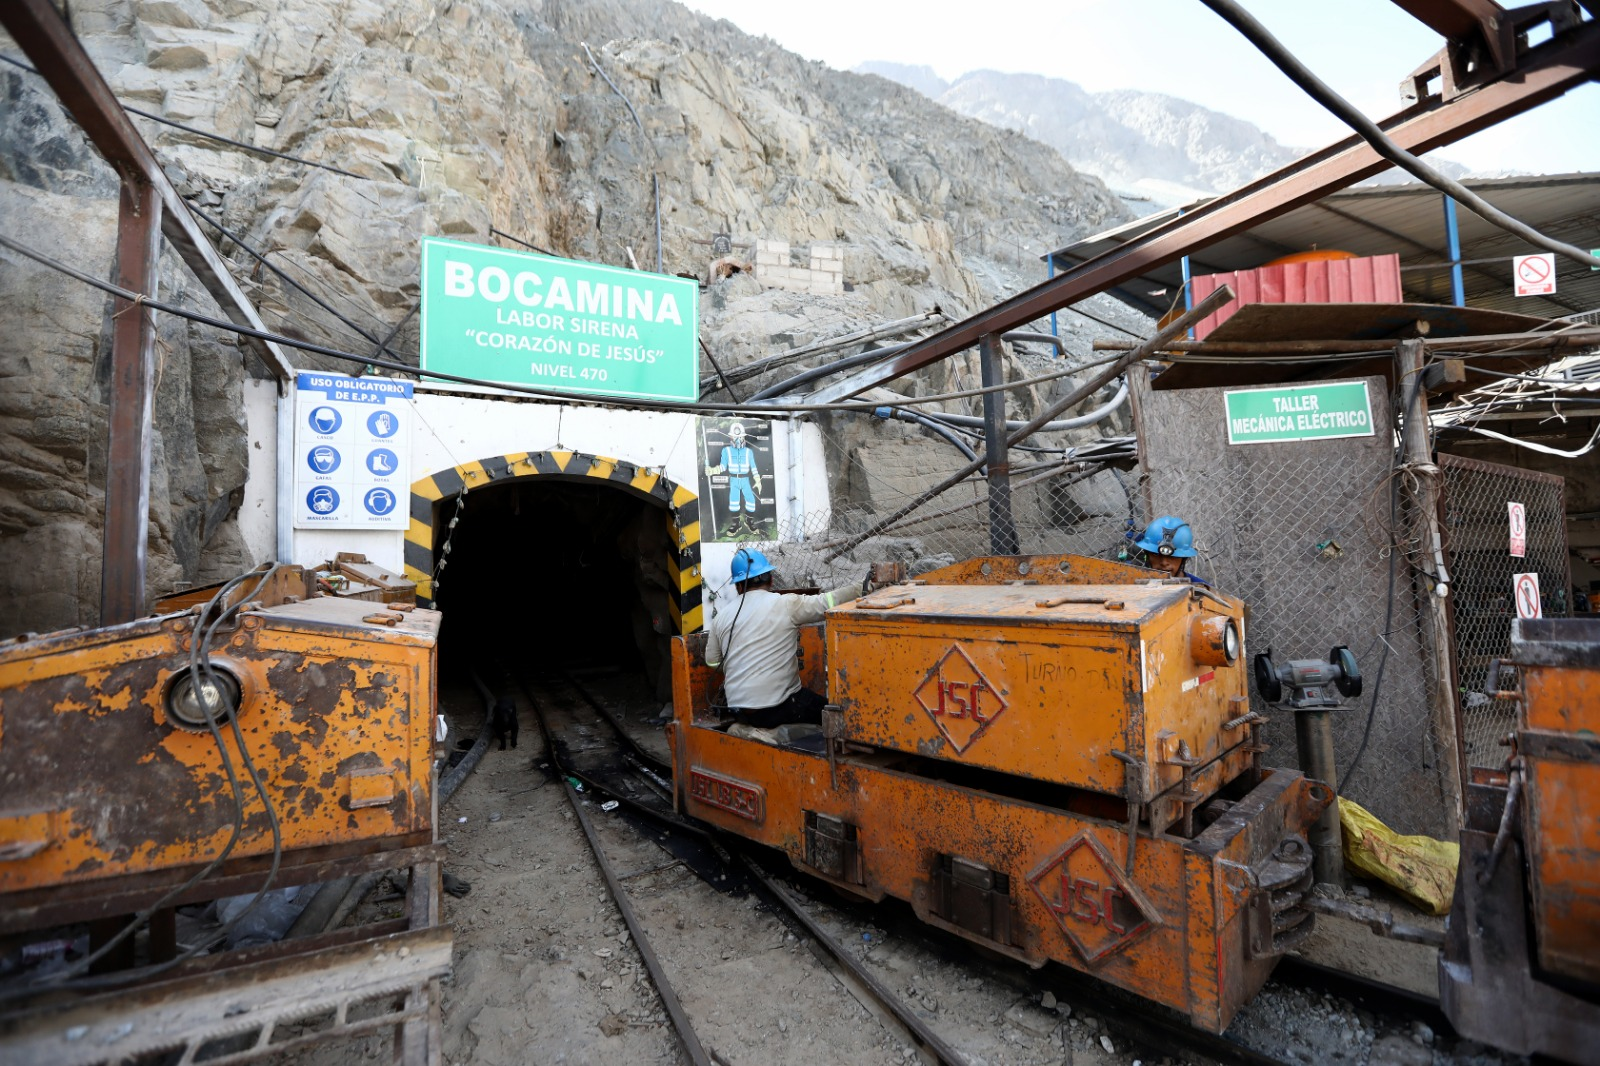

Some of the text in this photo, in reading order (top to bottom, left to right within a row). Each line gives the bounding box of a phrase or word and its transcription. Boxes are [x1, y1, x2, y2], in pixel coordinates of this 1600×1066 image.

[444, 260, 683, 326] BOCAMINA
[496, 308, 639, 340] LABOR SIRENA
[465, 329, 664, 364] “CORAZÓN DE JESÚS”
[310, 378, 404, 393] USO OBLIGATORIO
[531, 362, 608, 381] NIVEL 470
[335, 391, 380, 403] DE E.P.P.
[1272, 395, 1319, 413] TALLER
[1232, 410, 1367, 434] MECÁNICA ELÉCTRICO
[1018, 653, 1077, 684] TURNO
[930, 681, 987, 723] JSC
[1052, 872, 1125, 935] JSC
